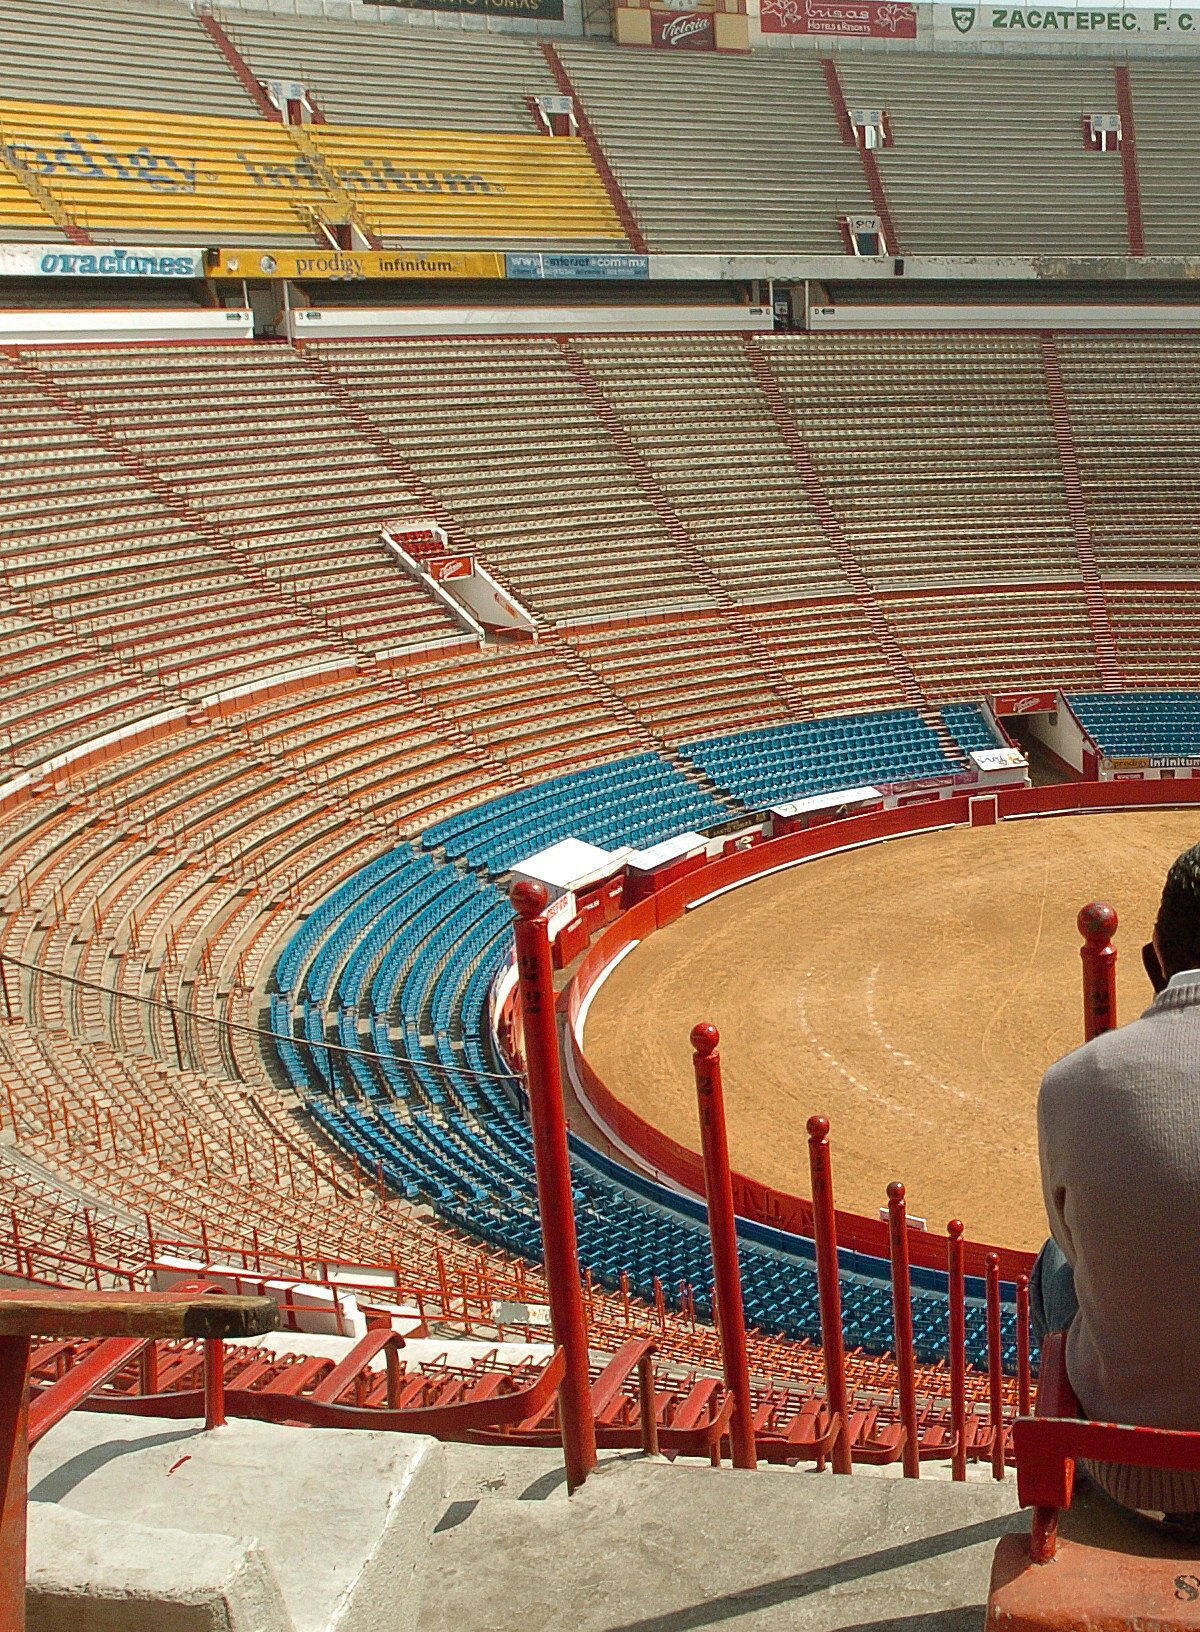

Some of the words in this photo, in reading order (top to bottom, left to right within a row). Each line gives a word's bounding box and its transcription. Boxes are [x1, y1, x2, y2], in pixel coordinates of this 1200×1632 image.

[805, 0, 869, 19] brisas
[992, 10, 1141, 32] ZACATEPEC,
[1153, 13, 1170, 31] F.
[1178, 13, 1196, 31] C.
[661, 13, 710, 45] Victoria
[40, 250, 195, 275] ovaciones
[296, 253, 364, 276] prodigy
[379, 256, 453, 272] infinitum
